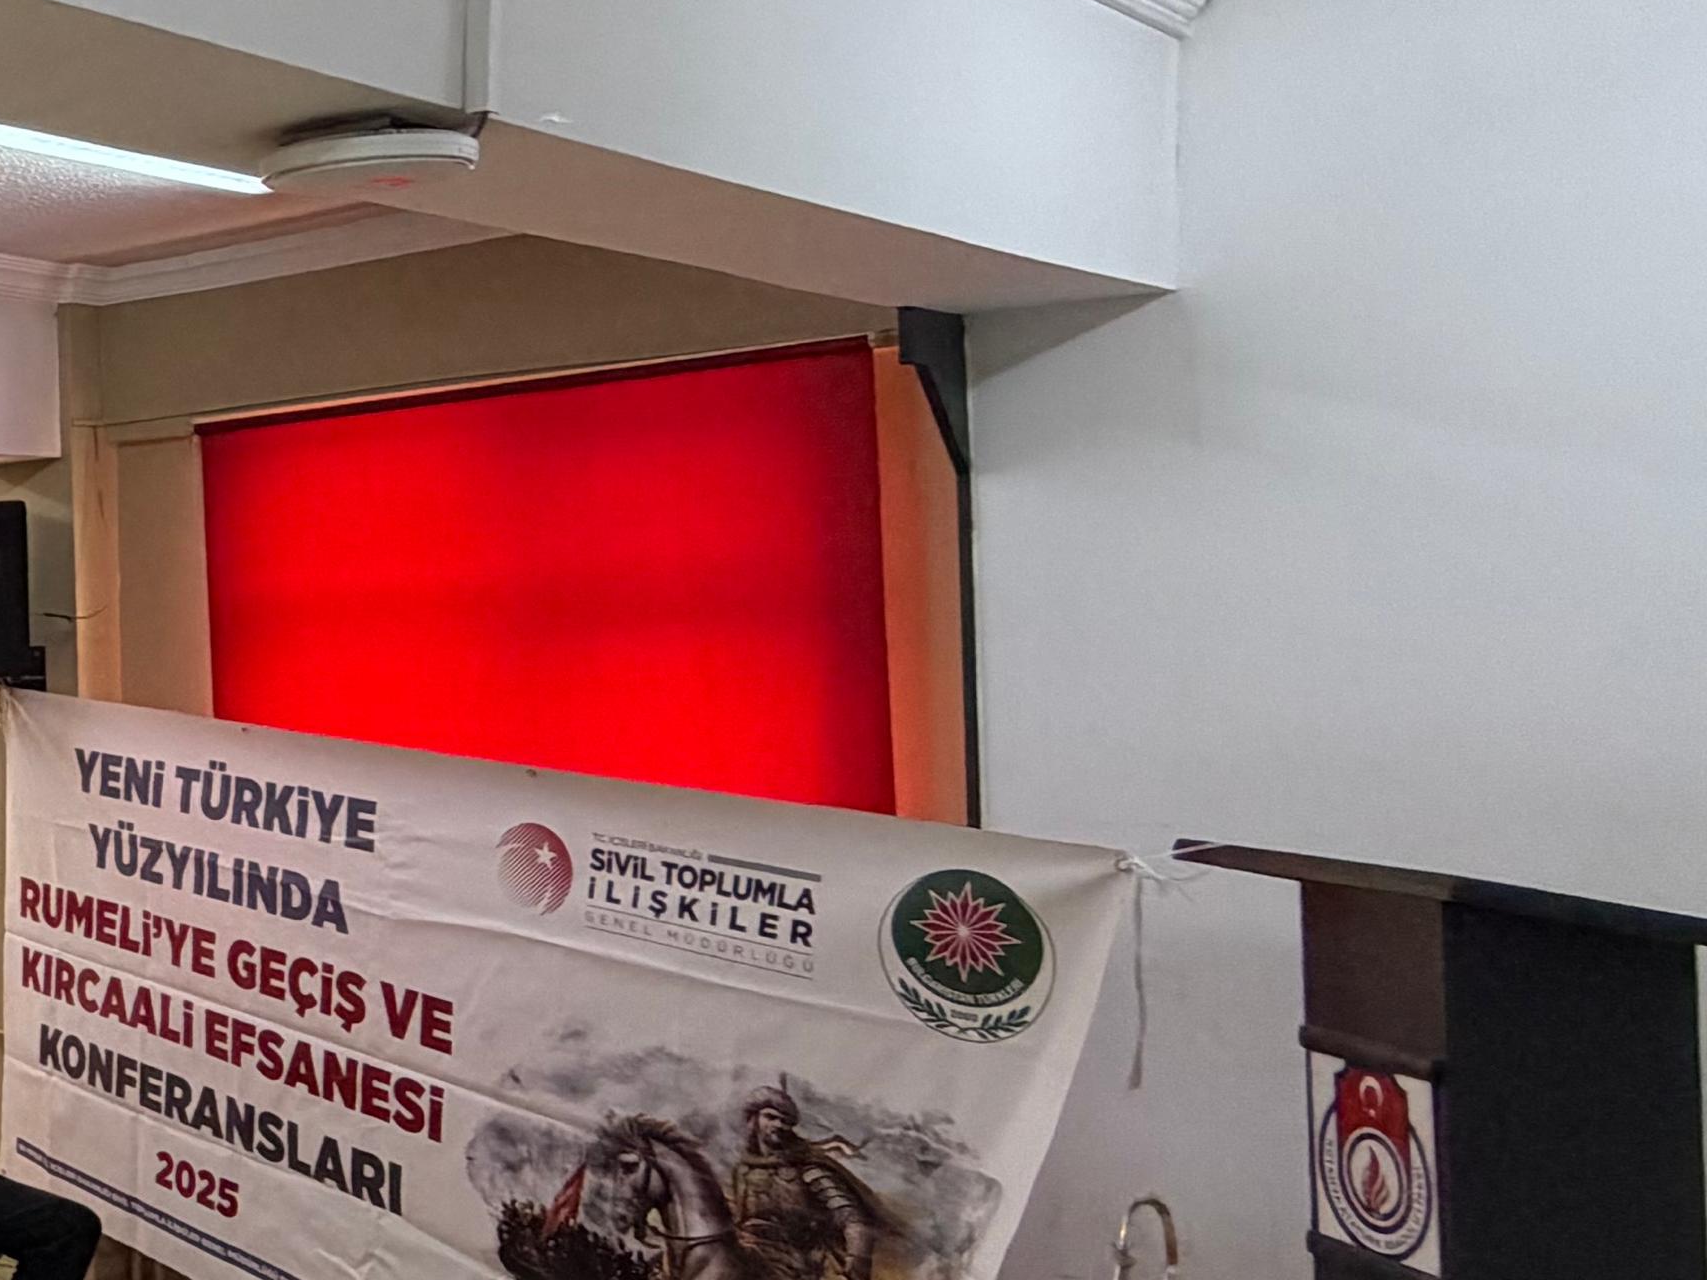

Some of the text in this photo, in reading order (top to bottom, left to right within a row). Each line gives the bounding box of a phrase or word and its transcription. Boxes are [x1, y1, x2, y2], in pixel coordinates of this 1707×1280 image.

[75, 748, 377, 853] YENİ TÜRKİYE
[88, 821, 349, 935] YÜZYILINDA
[588, 877, 813, 948] İLİŞKİLER
[589, 848, 816, 915] SİVİL TOPLUMLA
[22, 946, 445, 1143] KIRCAALİ EFSANESİ
[227, 939, 367, 1033] GEÇİŞ
[381, 981, 454, 1055] VE
[39, 1023, 402, 1216] KONFERANSLARI
[156, 1151, 239, 1218] 2025
